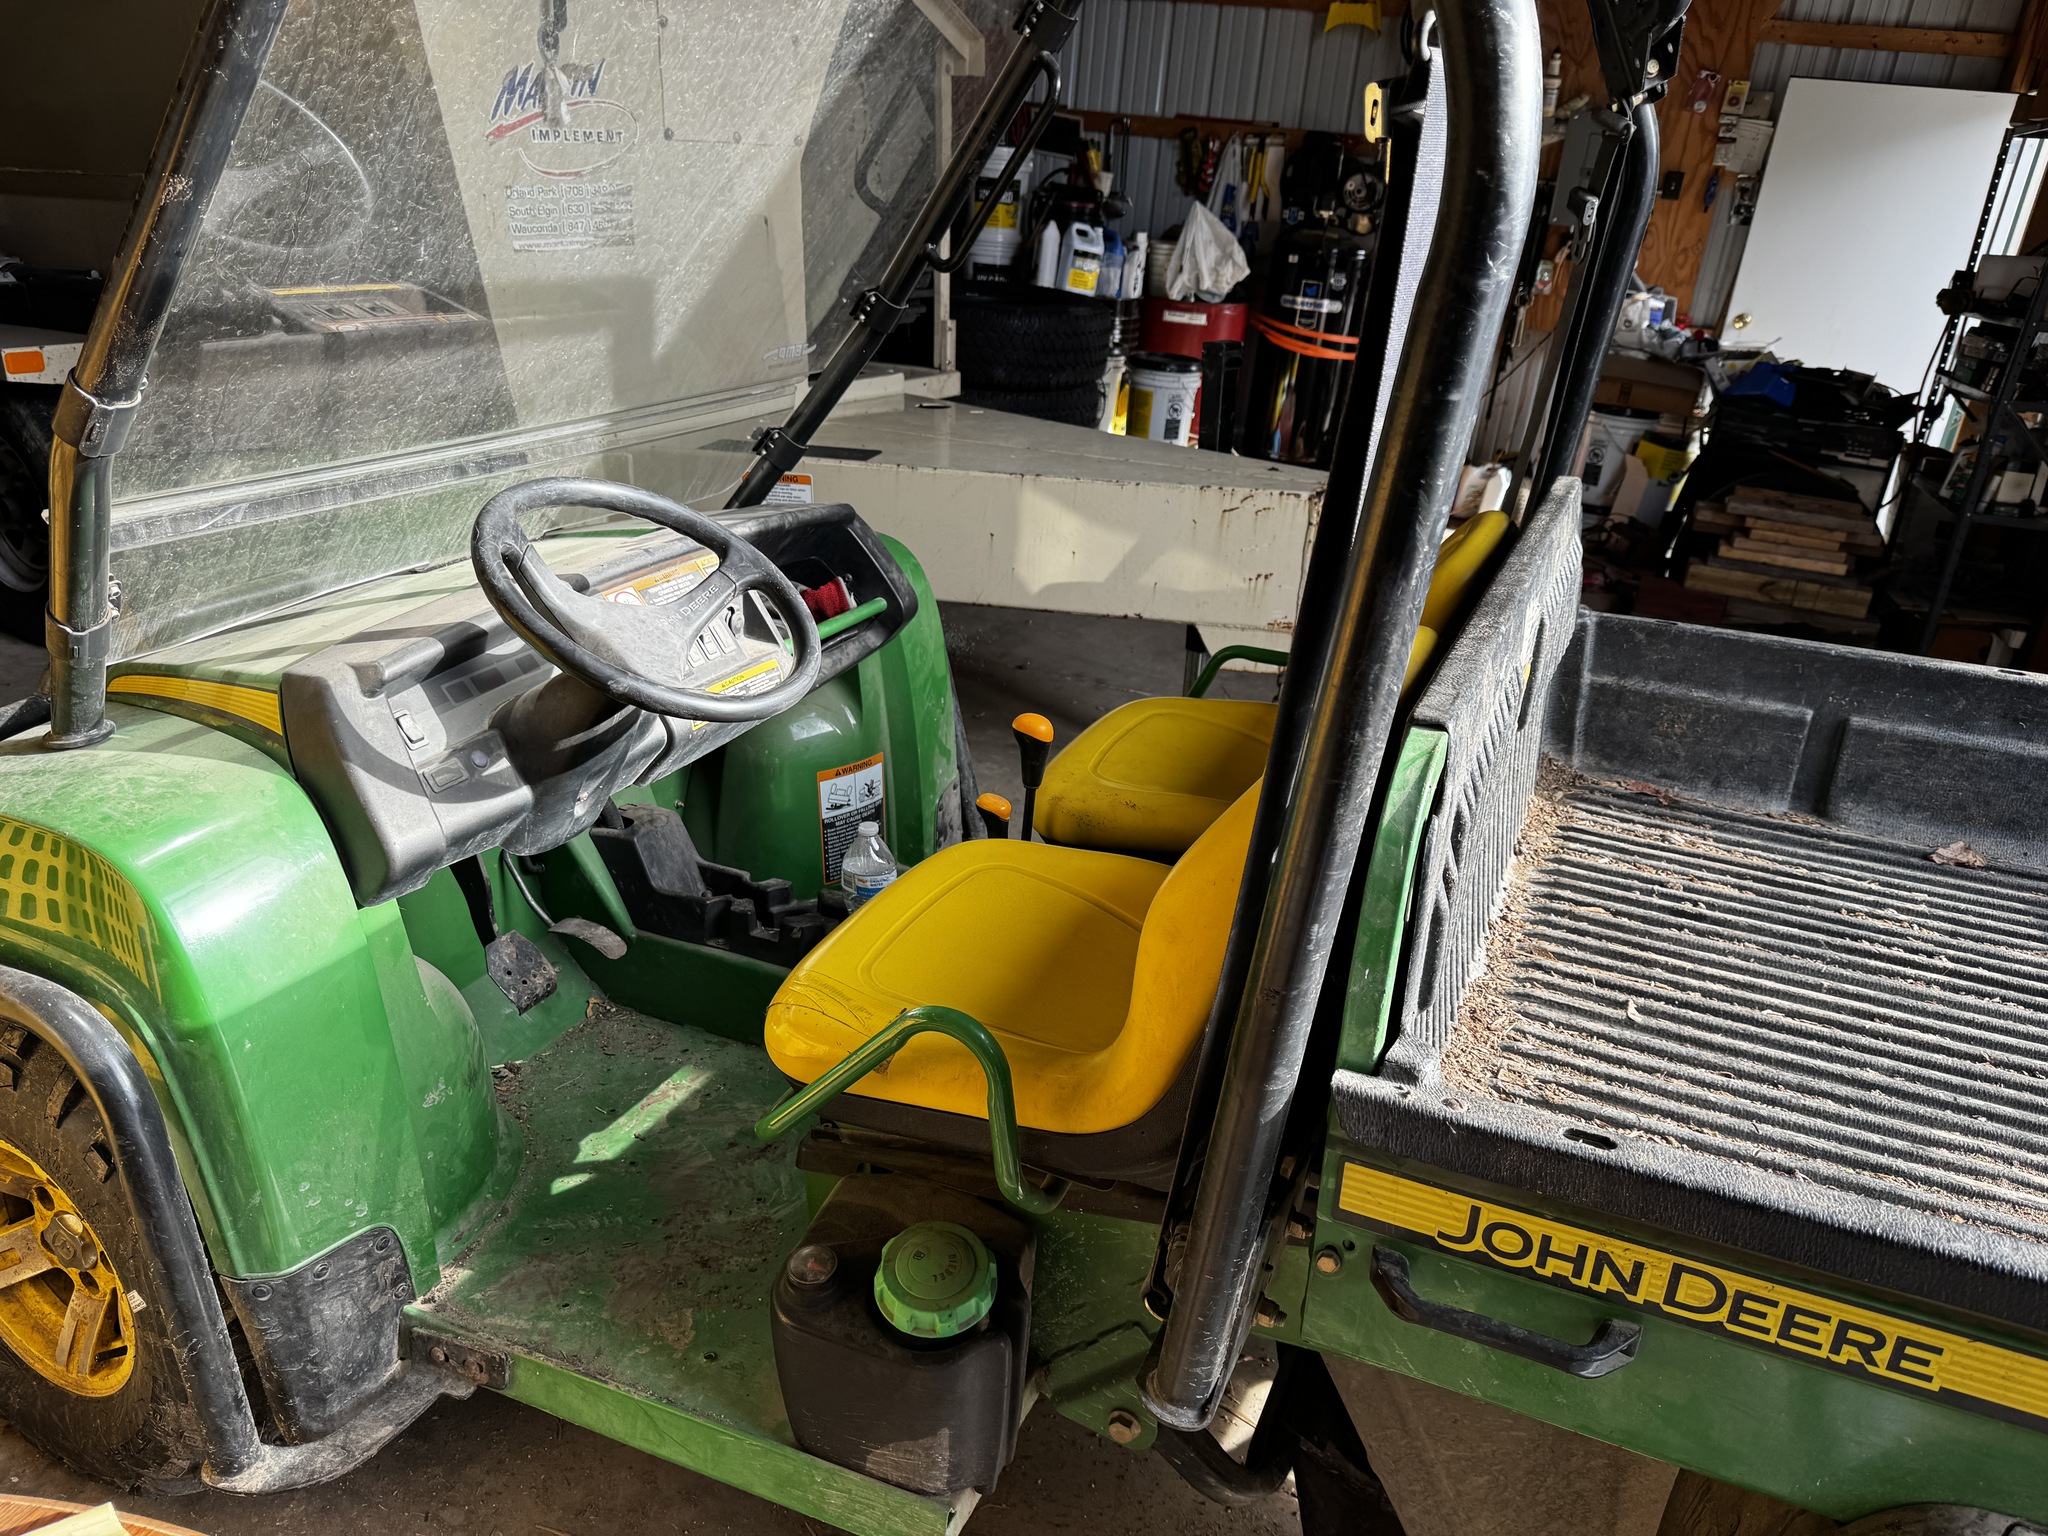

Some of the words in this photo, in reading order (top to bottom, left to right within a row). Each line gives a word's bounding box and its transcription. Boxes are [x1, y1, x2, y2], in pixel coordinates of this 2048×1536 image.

[531, 129, 625, 143] IMPLEMENT
[537, 185, 558, 197] Park
[508, 206, 535, 217] South
[537, 205, 558, 218] Elgin
[511, 222, 558, 234] Wauconda
[680, 584, 720, 617] DEERE
[725, 675, 745, 687] CAUTION
[841, 759, 873, 775] WARNING
[824, 812, 851, 824] ROLLOVER
[858, 803, 875, 814] FALLING
[835, 819, 846, 827] MAY
[846, 814, 861, 824] CAUSE
[861, 808, 876, 818] DEATH
[932, 1253, 958, 1283] DIESEL
[1435, 1204, 1647, 1297] JOHN
[1660, 1263, 1945, 1384] DEERE
